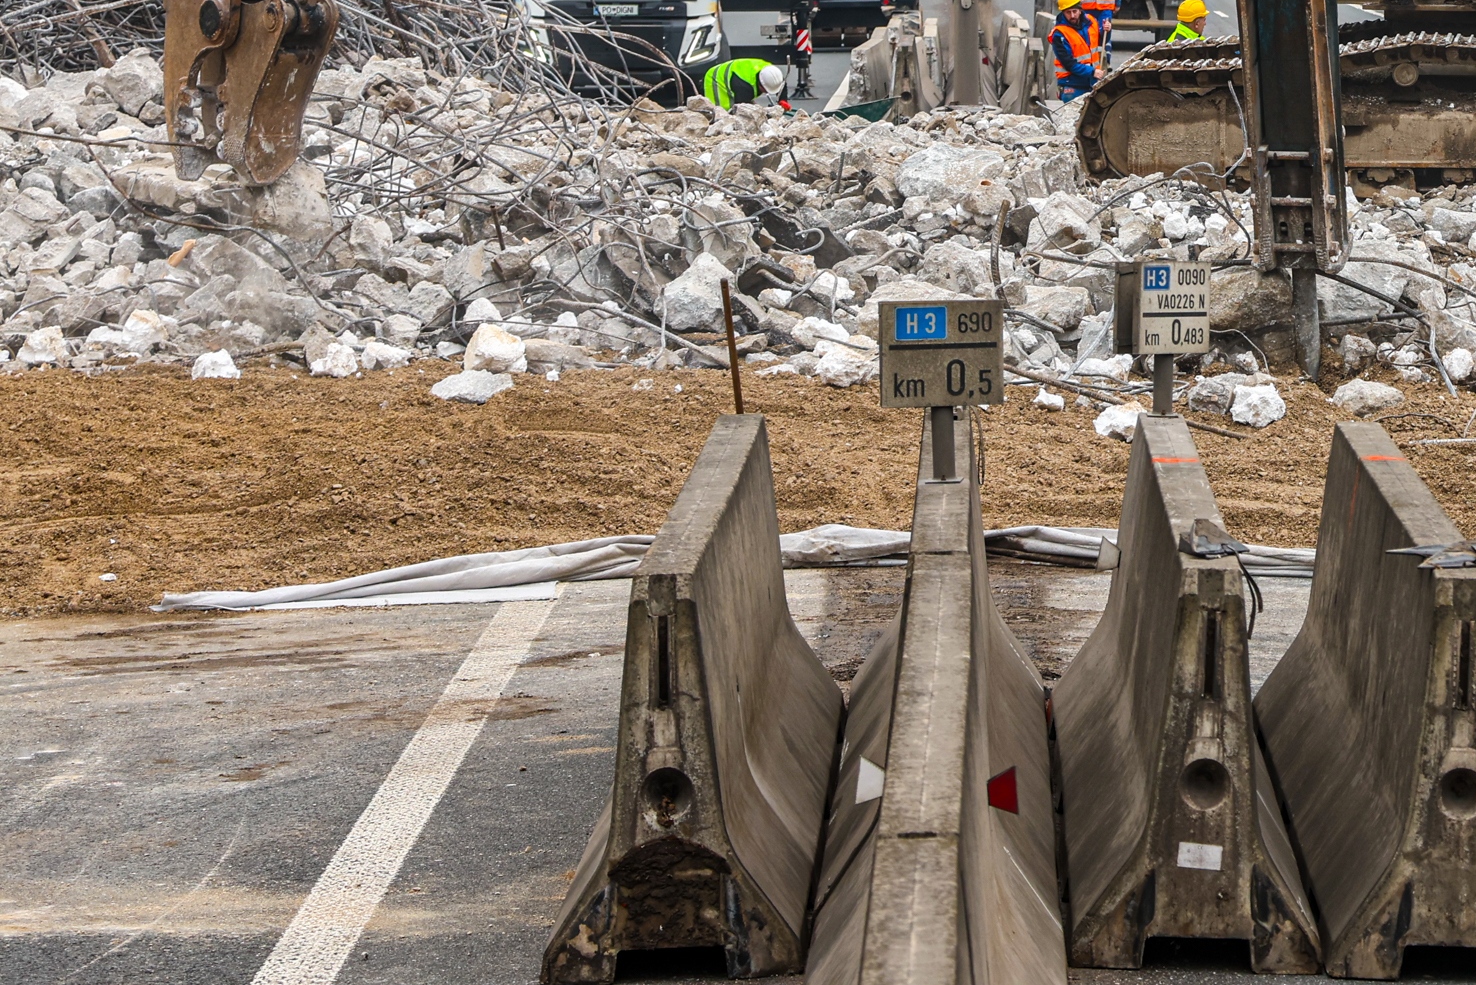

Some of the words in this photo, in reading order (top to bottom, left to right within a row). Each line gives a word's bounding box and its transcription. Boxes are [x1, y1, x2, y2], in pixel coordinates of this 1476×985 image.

[1178, 269, 1206, 286] 0090
[1157, 294, 1195, 309] VA0226
[1198, 293, 1205, 309] N
[957, 312, 993, 333] 690
[1145, 329, 1160, 346] km
[1171, 319, 1204, 347] 0,483
[893, 373, 925, 398] km
[946, 359, 992, 399] 0,5
